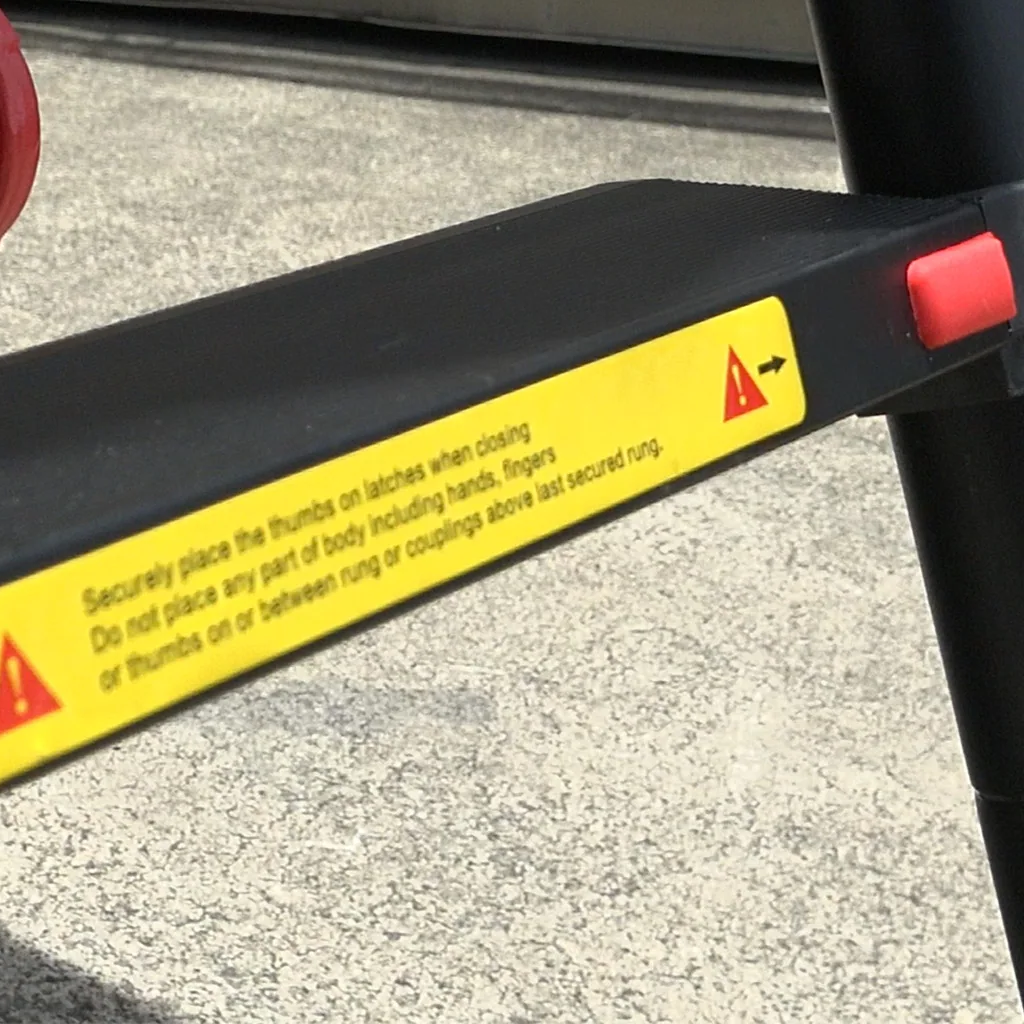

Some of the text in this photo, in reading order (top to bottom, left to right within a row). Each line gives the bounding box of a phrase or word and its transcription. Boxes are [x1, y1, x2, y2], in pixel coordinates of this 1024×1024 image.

[82, 421, 531, 616] Securely place the thumbs on latches when closing
[89, 445, 557, 654] Do not place any part of body including hands, fingers
[124, 631, 203, 681] thumbs
[205, 618, 232, 646] on
[234, 607, 255, 633] or
[257, 573, 338, 622] between
[338, 554, 382, 588] rung
[382, 541, 402, 568] or
[404, 510, 484, 559] couplings
[485, 489, 535, 525] above
[534, 477, 566, 503] last
[565, 447, 626, 489] secured
[626, 436, 664, 465] rung.
